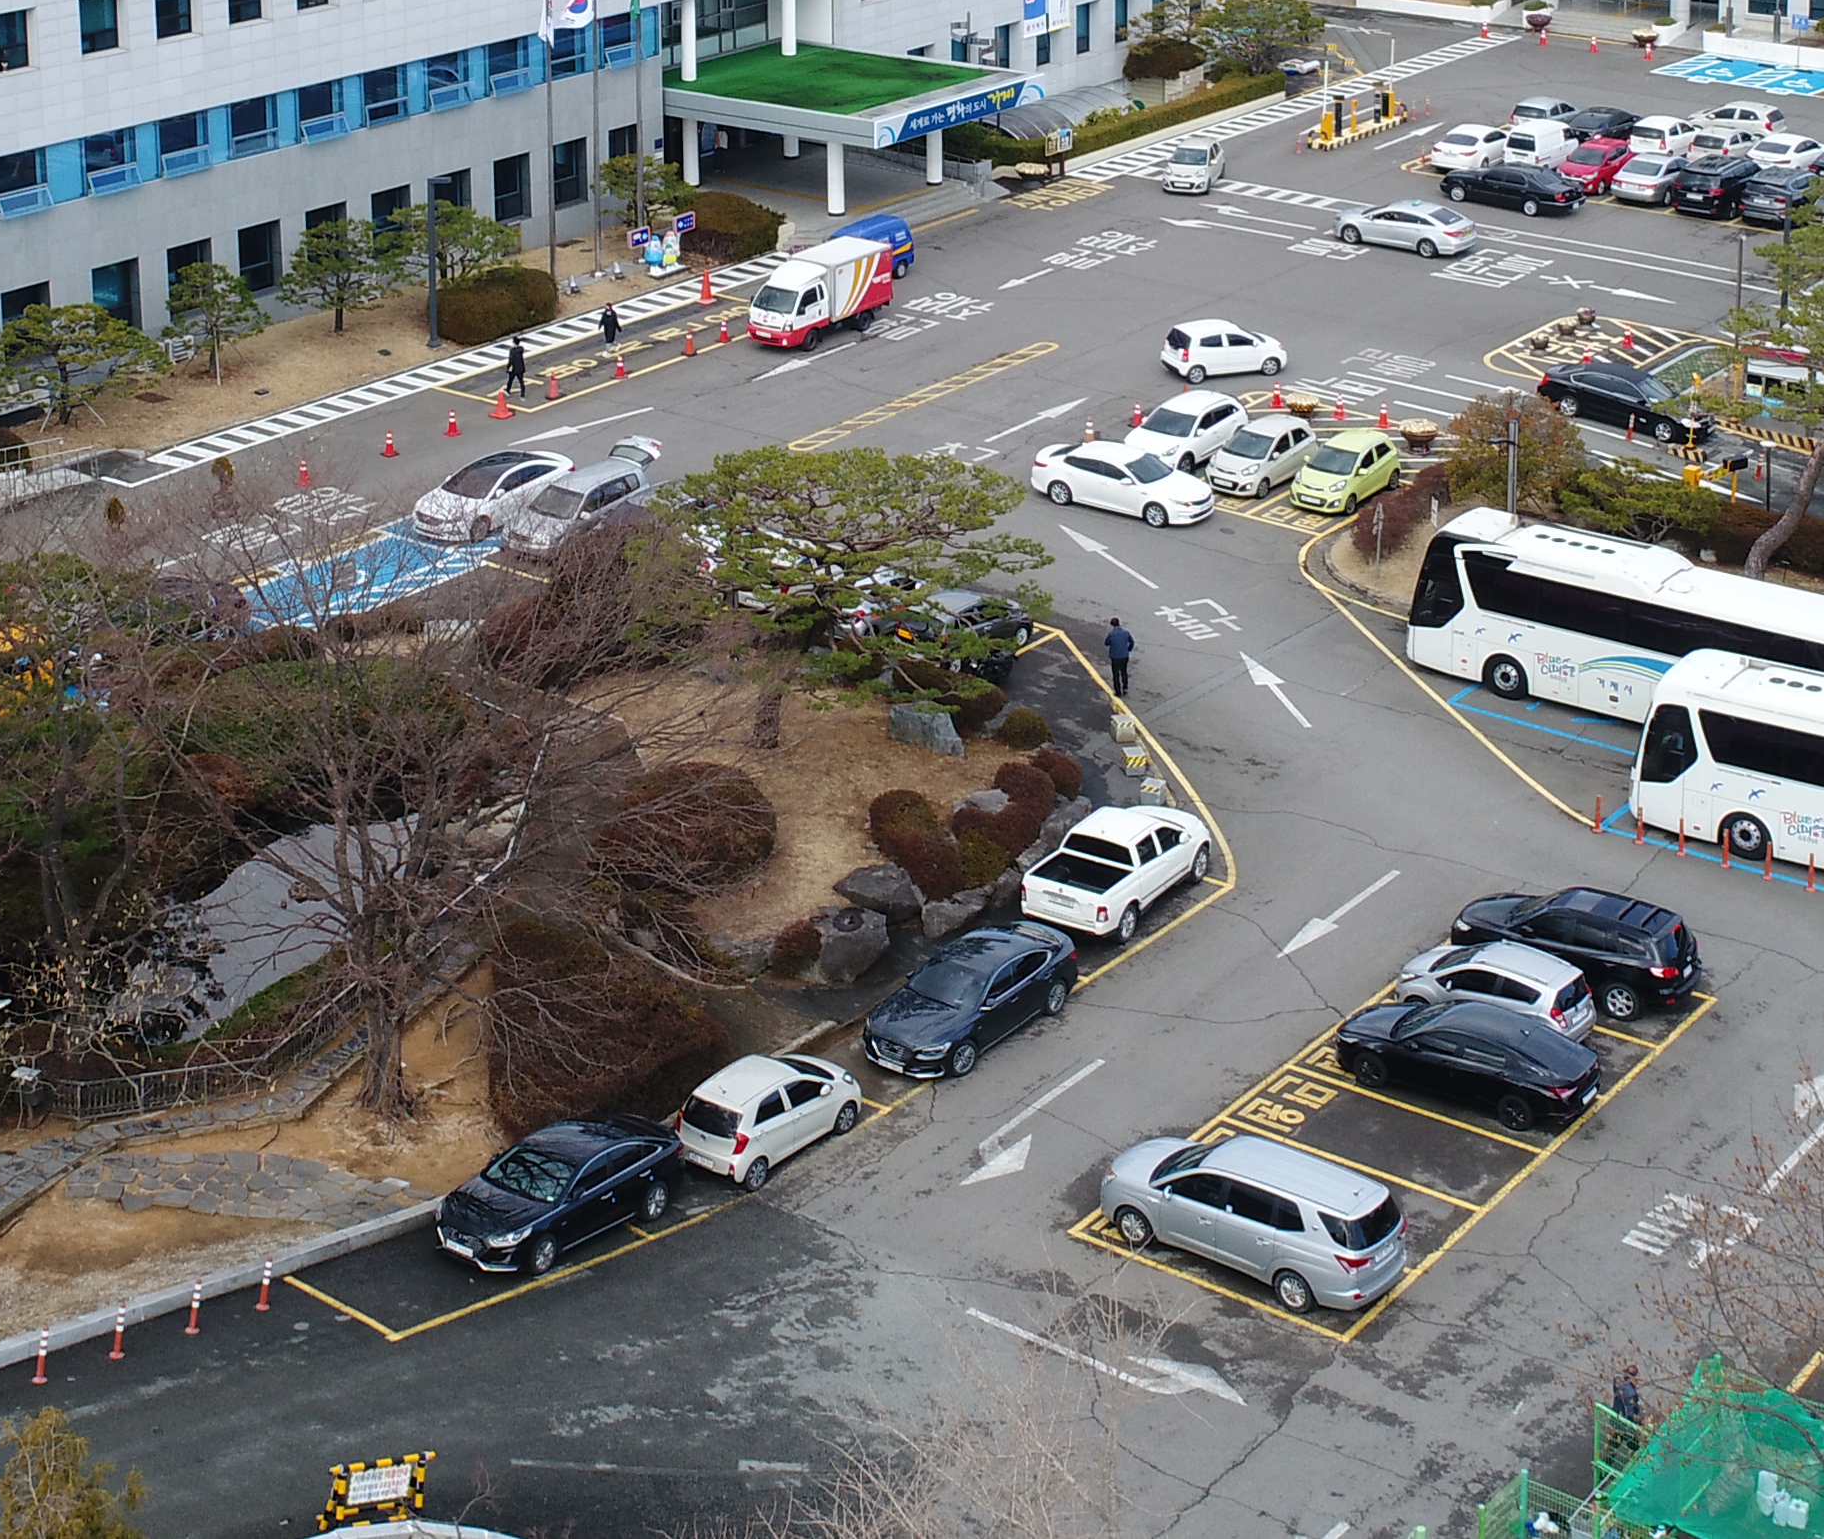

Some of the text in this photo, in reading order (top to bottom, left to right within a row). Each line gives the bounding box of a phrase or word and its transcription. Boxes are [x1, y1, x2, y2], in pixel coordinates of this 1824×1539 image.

[1535, 652, 1562, 665] Blue
[1540, 663, 1562, 677] City
[1596, 677, 1634, 696] 거제시
[1782, 812, 1813, 825] Blue
[1787, 823, 1813, 838] City
